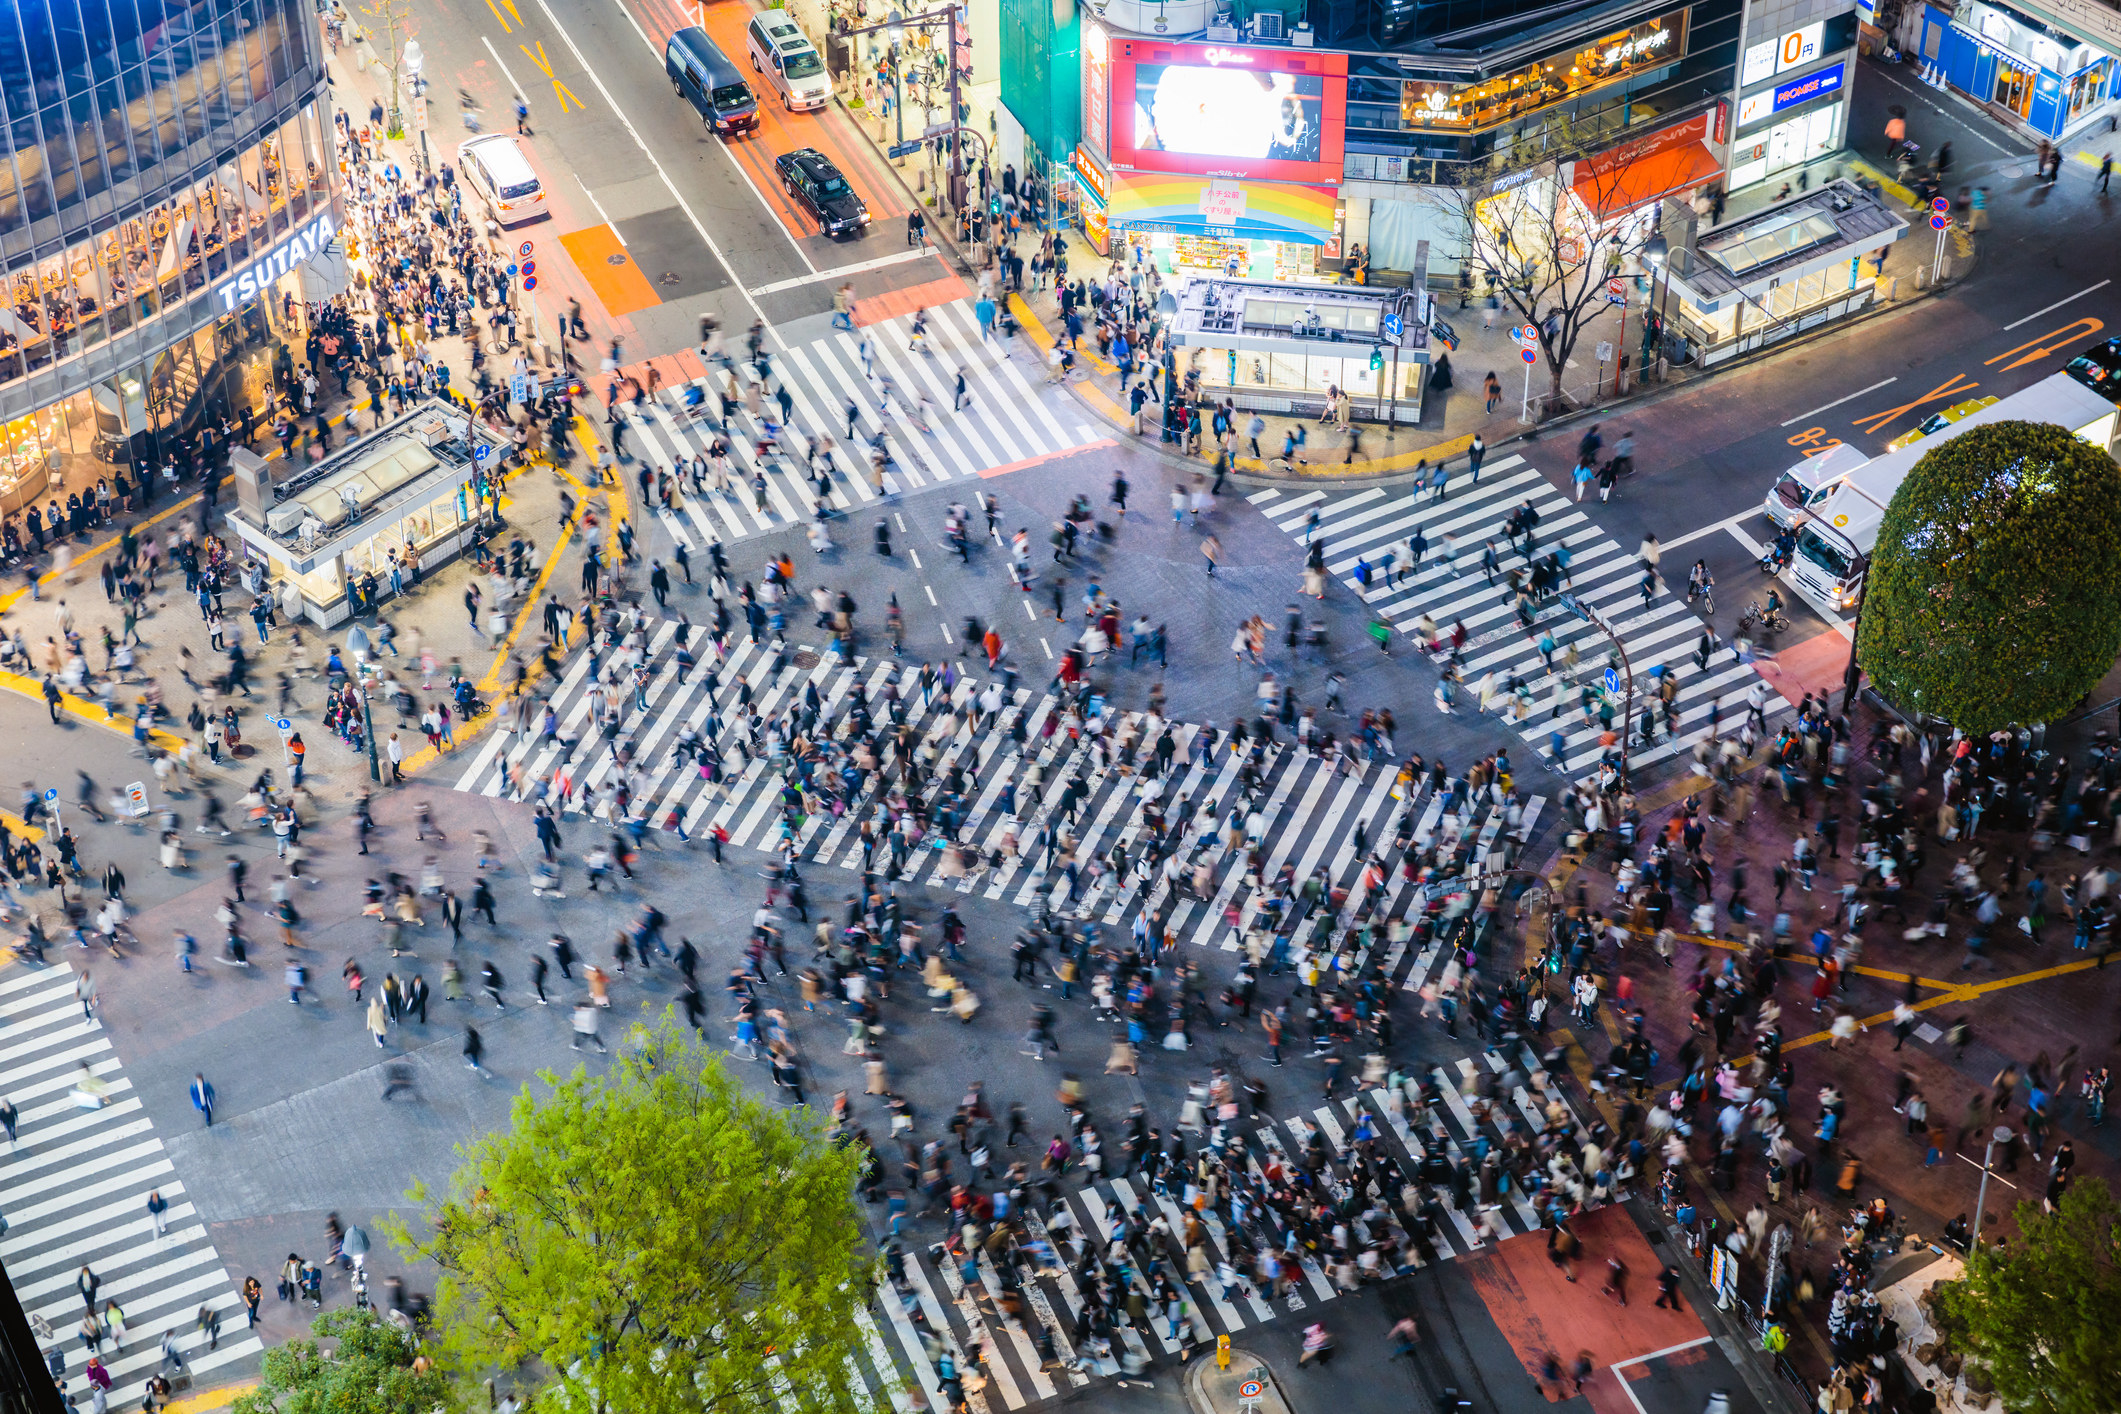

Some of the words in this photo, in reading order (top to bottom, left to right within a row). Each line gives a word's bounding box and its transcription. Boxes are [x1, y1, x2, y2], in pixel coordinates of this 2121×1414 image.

[1205, 47, 1254, 66] Glico
[1783, 32, 1813, 64] 0円
[1777, 79, 1820, 104] PROMISE
[1415, 109, 1457, 120] COFFEE
[1208, 190, 1239, 199] ハチ公前
[1123, 222, 1176, 232] SANZENRI
[219, 215, 334, 310] TSUTAYA
